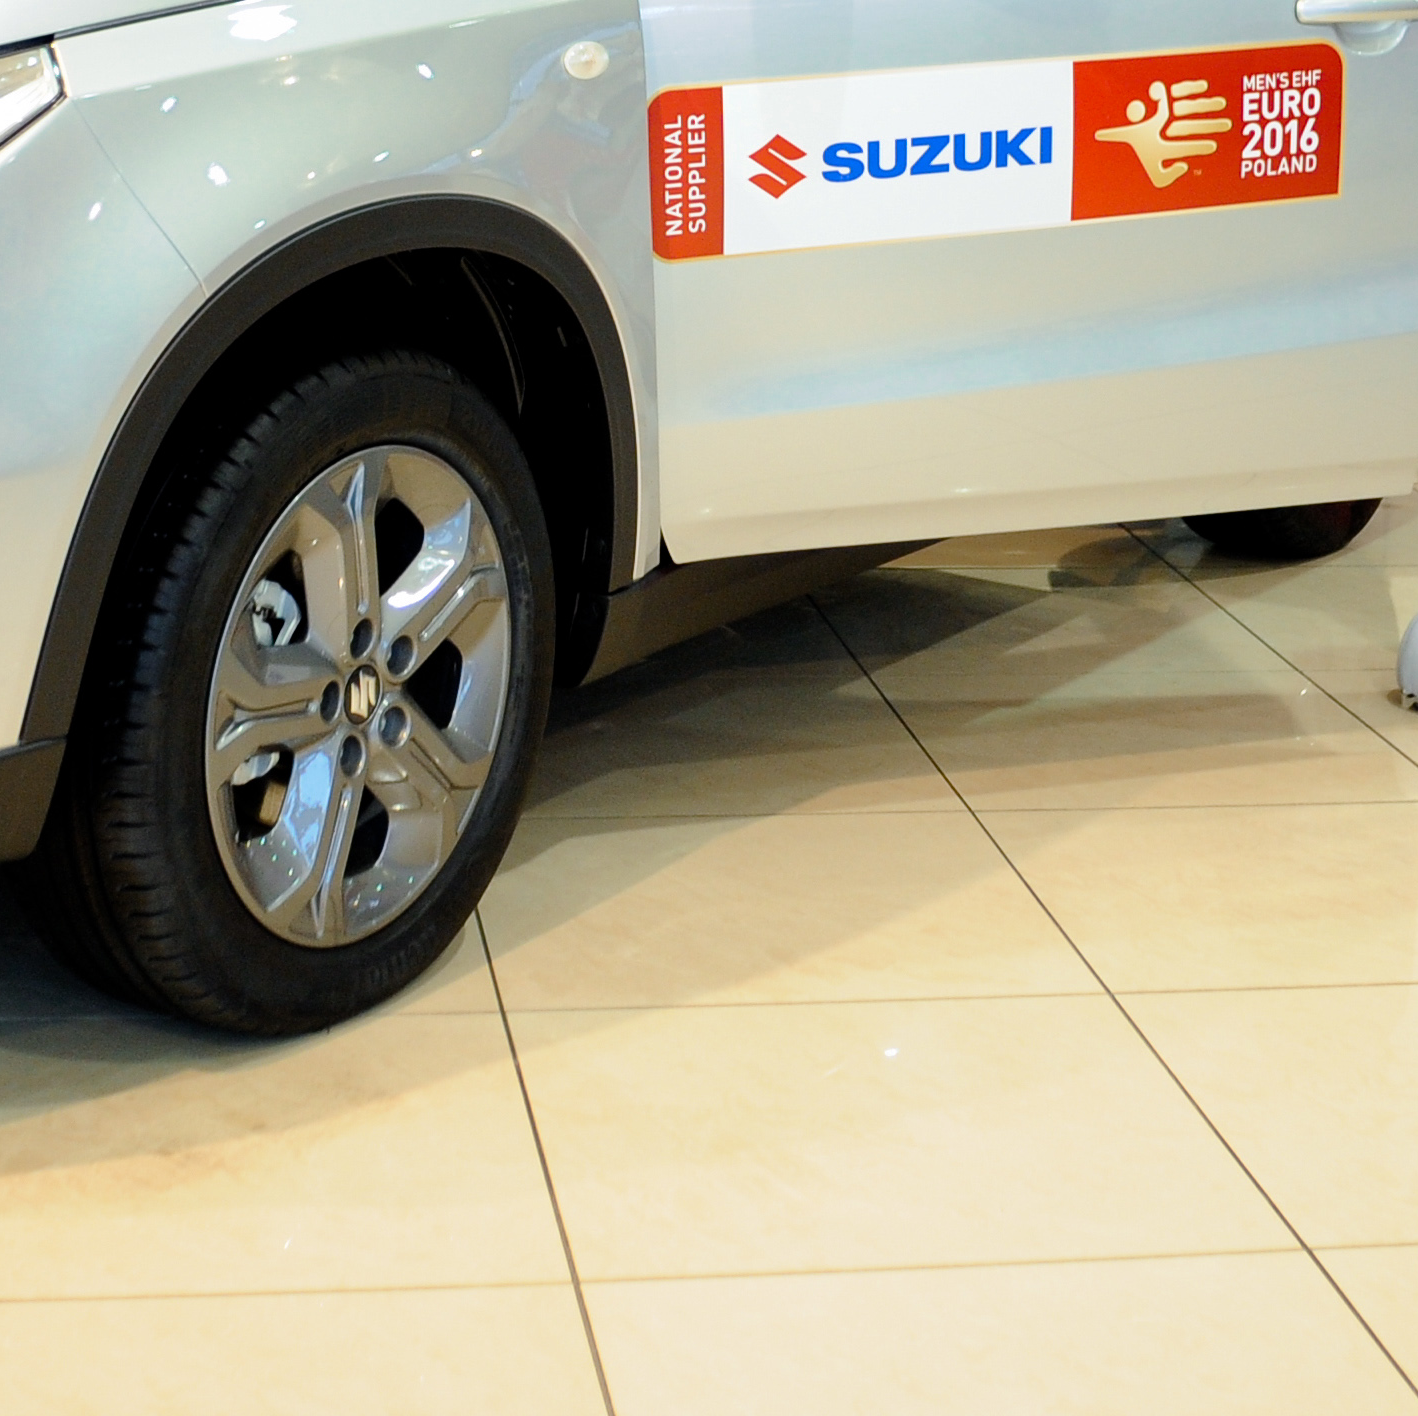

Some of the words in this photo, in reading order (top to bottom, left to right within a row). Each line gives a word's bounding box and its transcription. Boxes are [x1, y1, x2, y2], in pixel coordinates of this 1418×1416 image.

[1242, 72, 1289, 92] MEN'S
[1292, 69, 1322, 88] EHF
[1242, 87, 1321, 122] EURO
[821, 126, 1053, 184] SUZUKI
[1241, 117, 1319, 159] 2016
[664, 114, 683, 237] NATIONAL
[687, 114, 707, 234] SUPPLIER
[1240, 154, 1318, 180] POLAND
